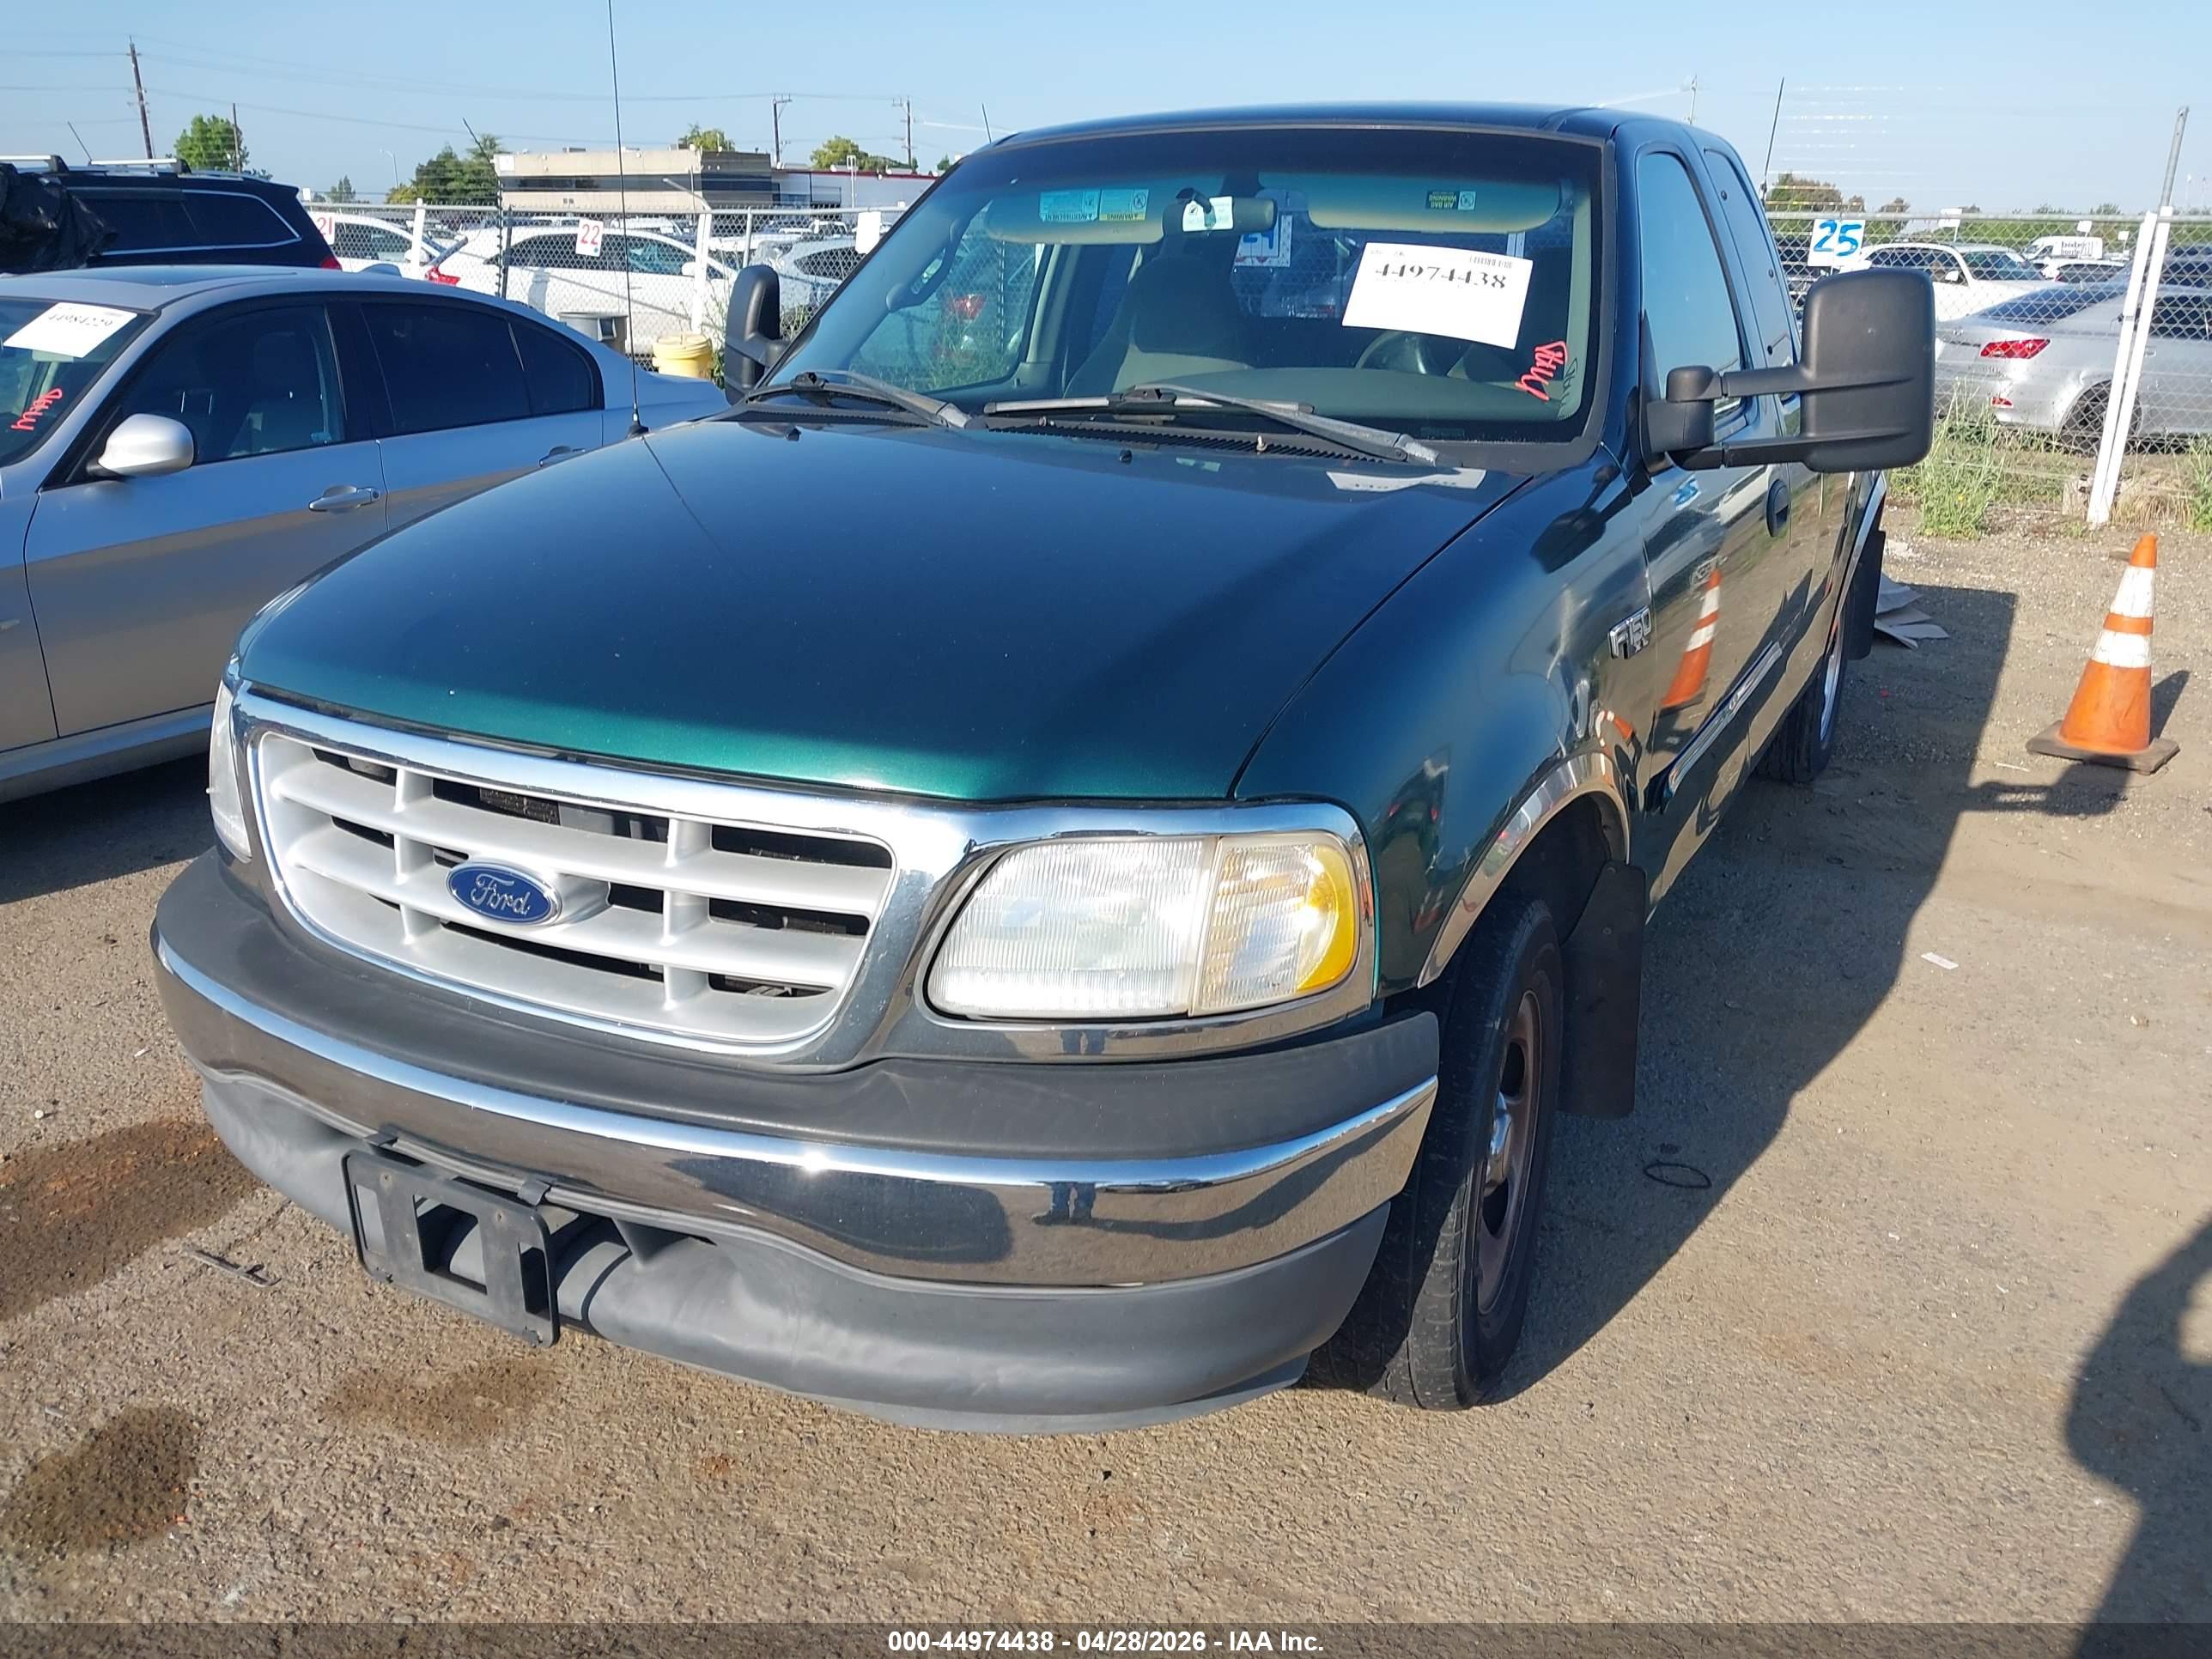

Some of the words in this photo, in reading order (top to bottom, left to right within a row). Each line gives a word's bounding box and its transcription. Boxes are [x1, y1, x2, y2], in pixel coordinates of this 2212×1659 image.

[317, 216, 332, 235] 21
[580, 223, 600, 245] 22
[1814, 219, 1862, 256] 25
[1375, 263, 1507, 289] 44974438
[1634, 636, 1649, 653] XL
[471, 873, 532, 915] Ford
